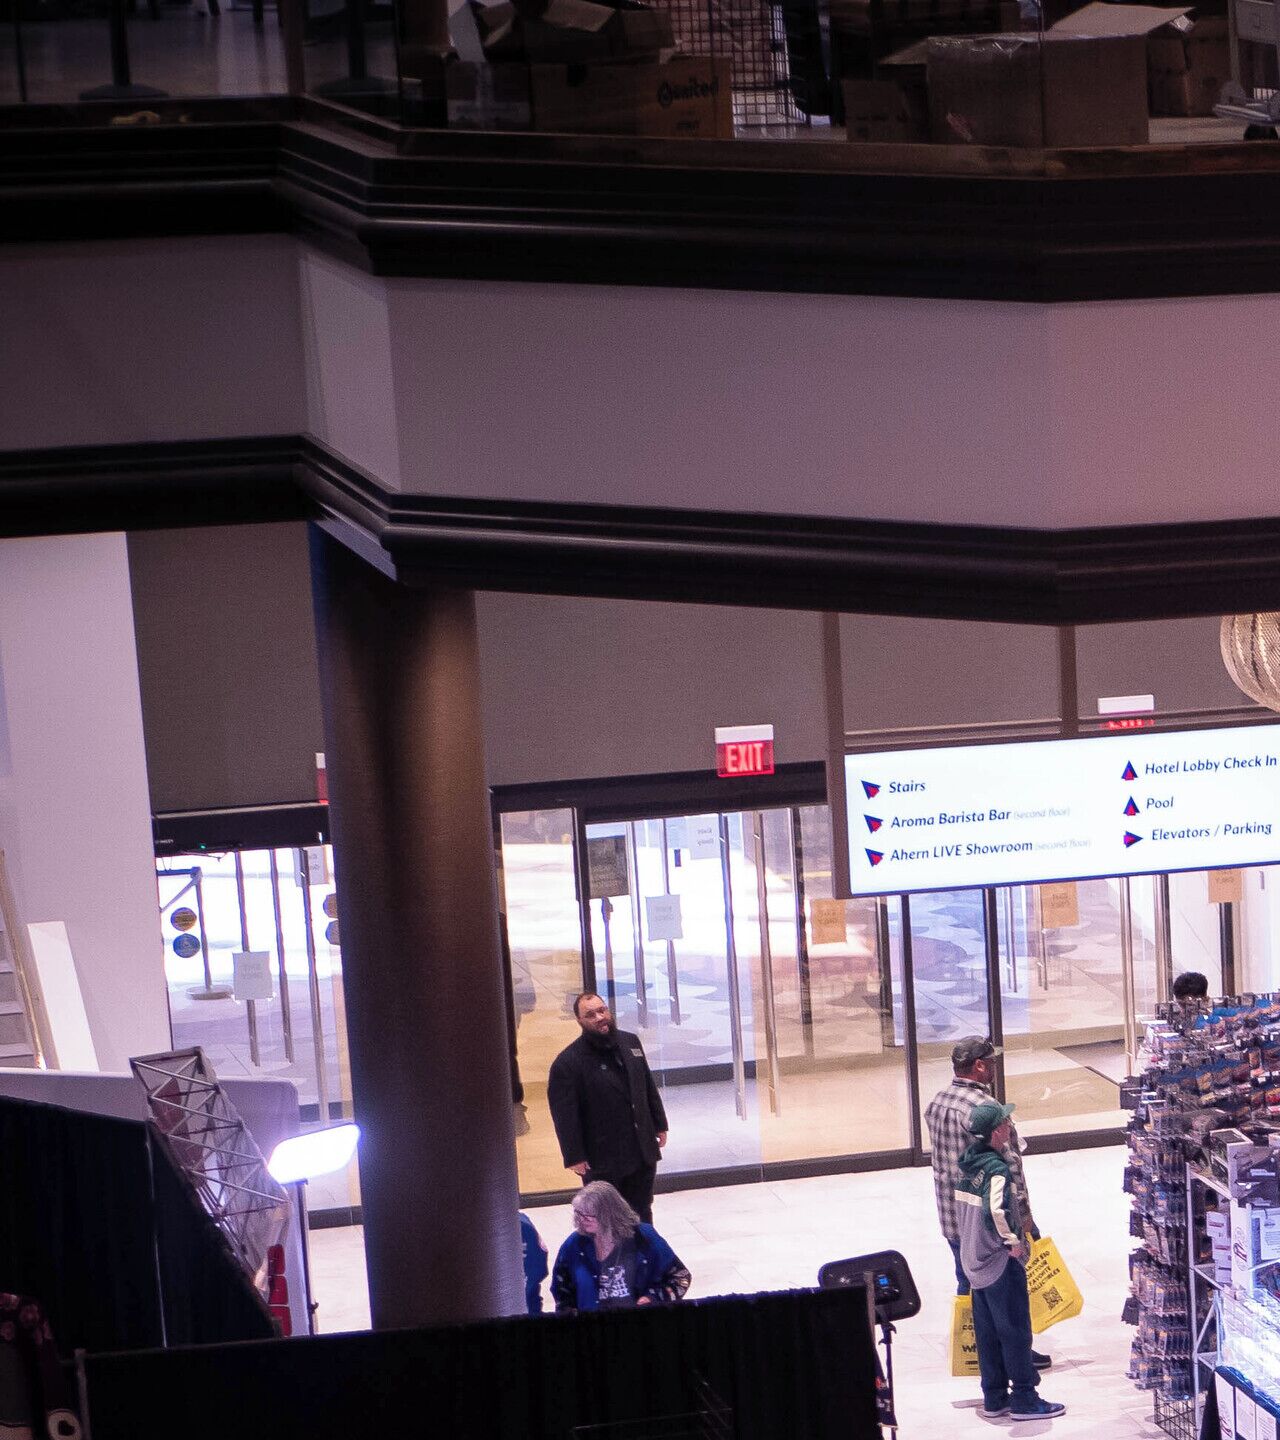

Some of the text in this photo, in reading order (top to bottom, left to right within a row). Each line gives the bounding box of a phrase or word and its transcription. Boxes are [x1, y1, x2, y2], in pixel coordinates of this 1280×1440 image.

[726, 742, 764, 773] EXIT
[1145, 755, 1277, 774] Hotel Lobby Check In
[889, 780, 926, 794] Stairs
[1146, 796, 1175, 809] Pool
[890, 816, 935, 829] Aroma
[938, 811, 985, 825] Barista
[988, 809, 1011, 821] Bar
[1152, 826, 1211, 841] Elevators
[1223, 821, 1273, 836] Parking
[890, 849, 929, 862] Ahern
[933, 844, 963, 859] LIVE
[966, 840, 1034, 857] Showroom
